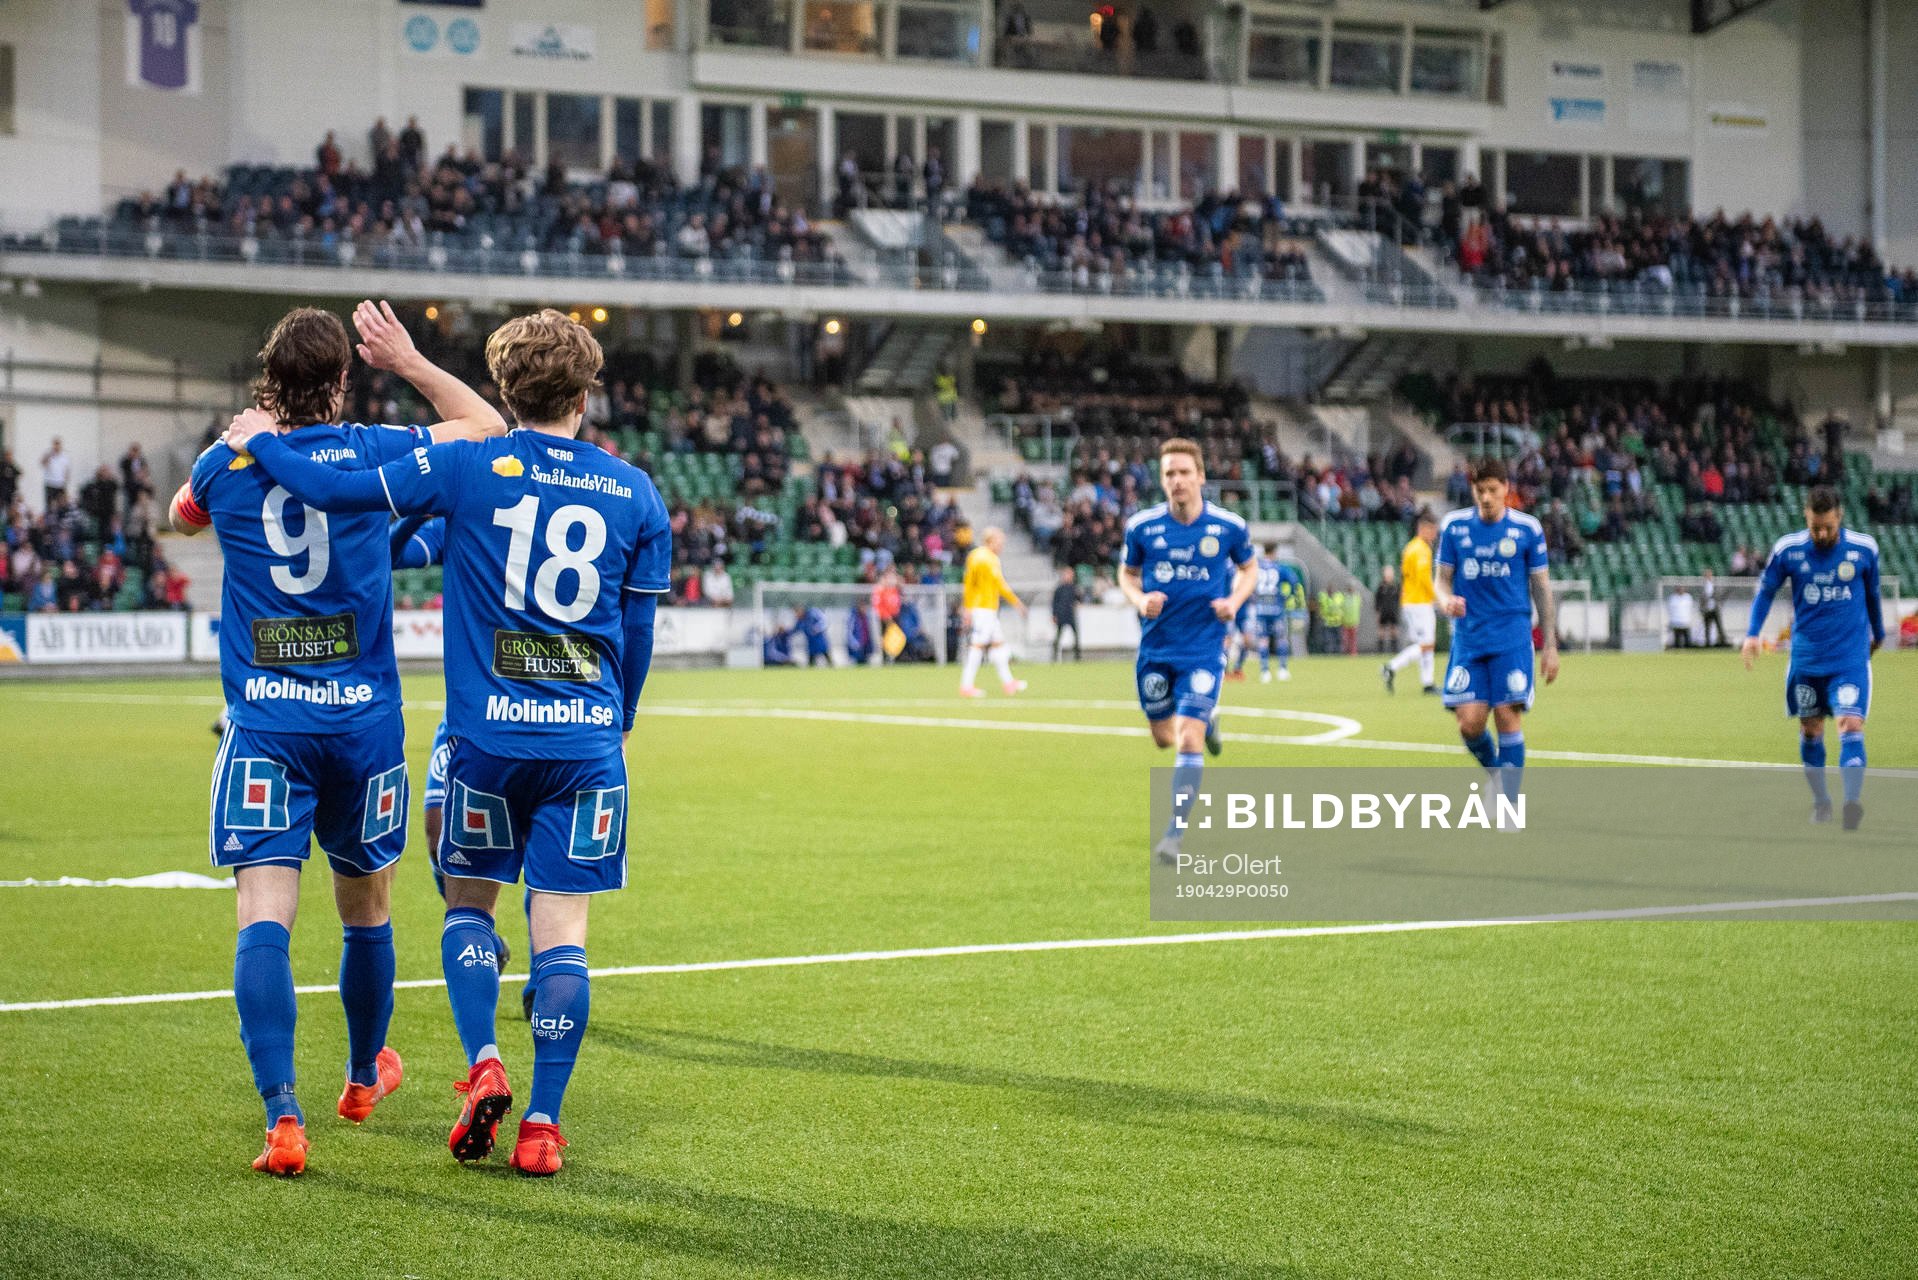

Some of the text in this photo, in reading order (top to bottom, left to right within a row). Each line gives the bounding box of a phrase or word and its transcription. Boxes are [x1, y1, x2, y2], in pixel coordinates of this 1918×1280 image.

[530, 464, 632, 499] SmålandsVillan
[262, 484, 330, 595] 9
[492, 494, 607, 623] 18
[258, 622, 346, 643] GRÖNSAKS
[278, 640, 335, 658] HUSET
[501, 638, 591, 658] GRÖNSAKS
[524, 657, 581, 674] HUSET
[245, 676, 373, 705] Molinbil.se
[486, 695, 613, 727] Molinbil.se
